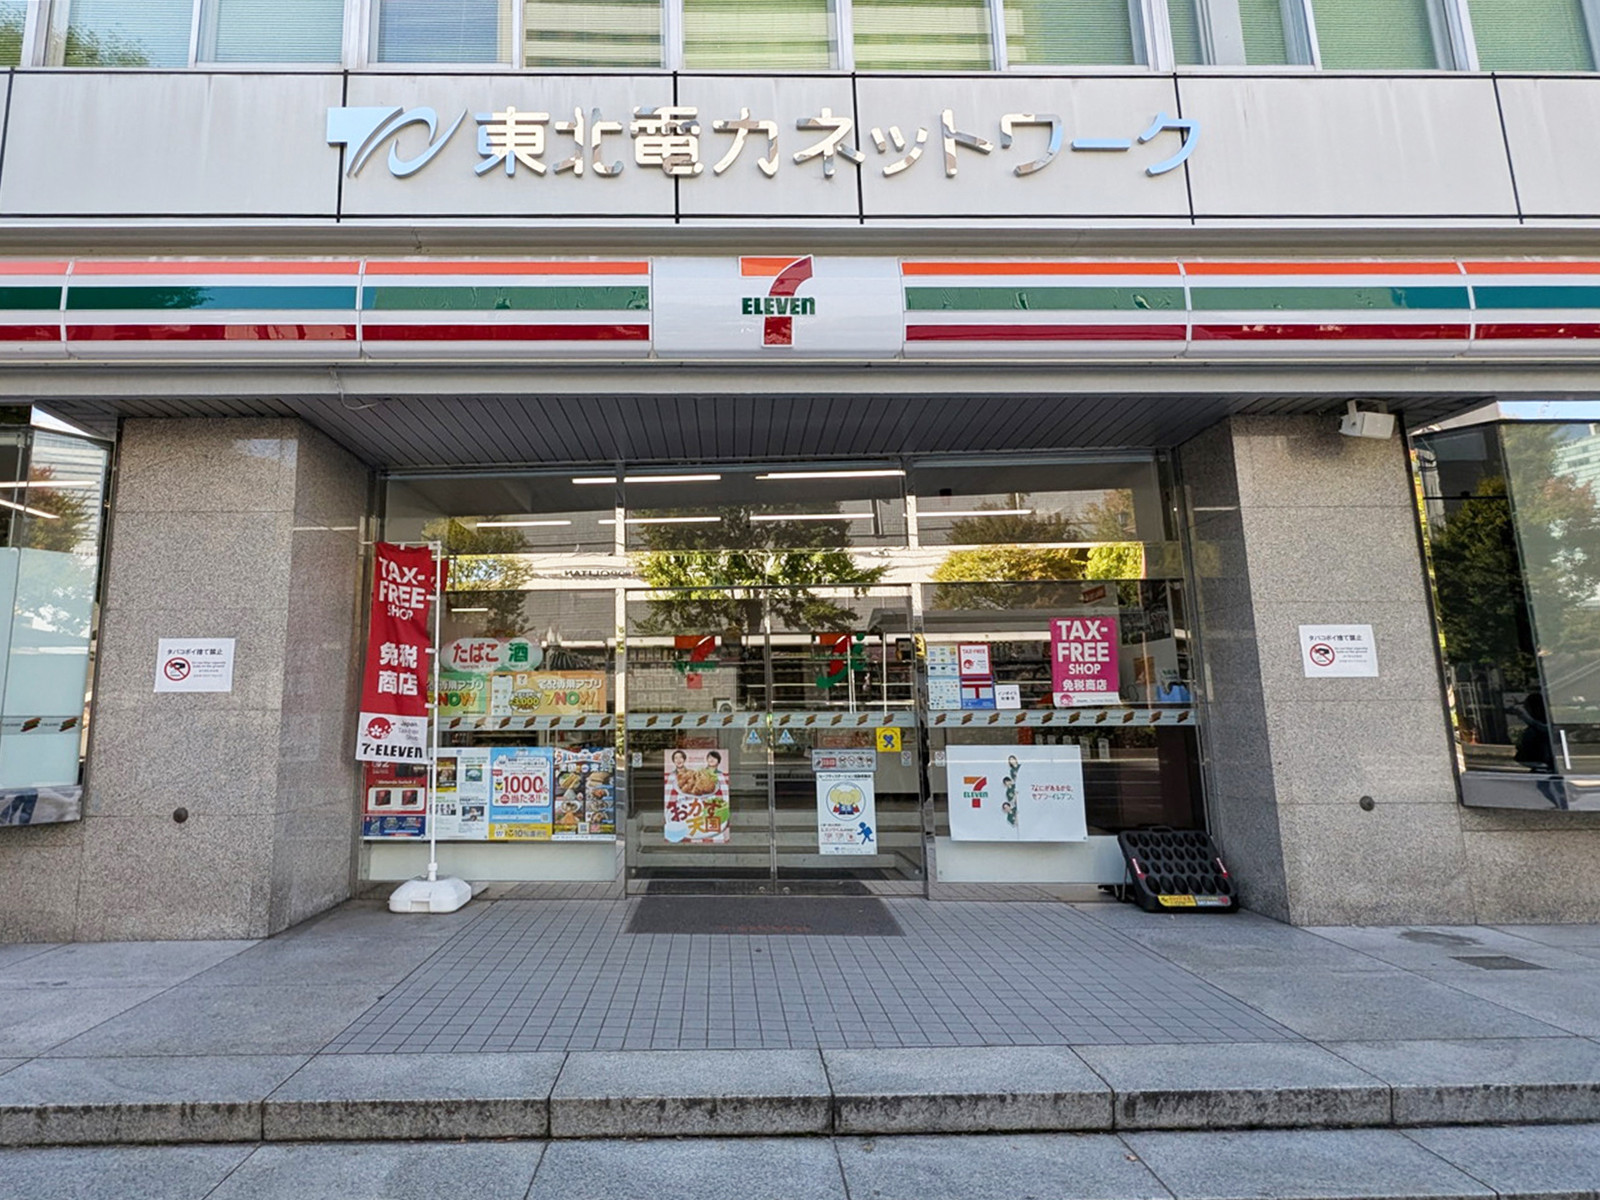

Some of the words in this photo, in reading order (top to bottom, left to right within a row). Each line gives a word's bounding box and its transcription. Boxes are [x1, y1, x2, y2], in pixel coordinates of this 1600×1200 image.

[474, 105, 1201, 178] 東北電力ネットワーク
[740, 255, 813, 346] 7
[378, 556, 425, 585] TAX-
[378, 580, 426, 609] FREE
[1056, 619, 1109, 641] TAX-
[379, 641, 418, 669] 免税
[452, 642, 500, 664] たばこ
[507, 642, 529, 663] 酒
[1056, 641, 1110, 663] FREE
[377, 669, 418, 696] 商店
[1068, 663, 1102, 675] SHOP
[1062, 679, 1108, 691] 免税商店
